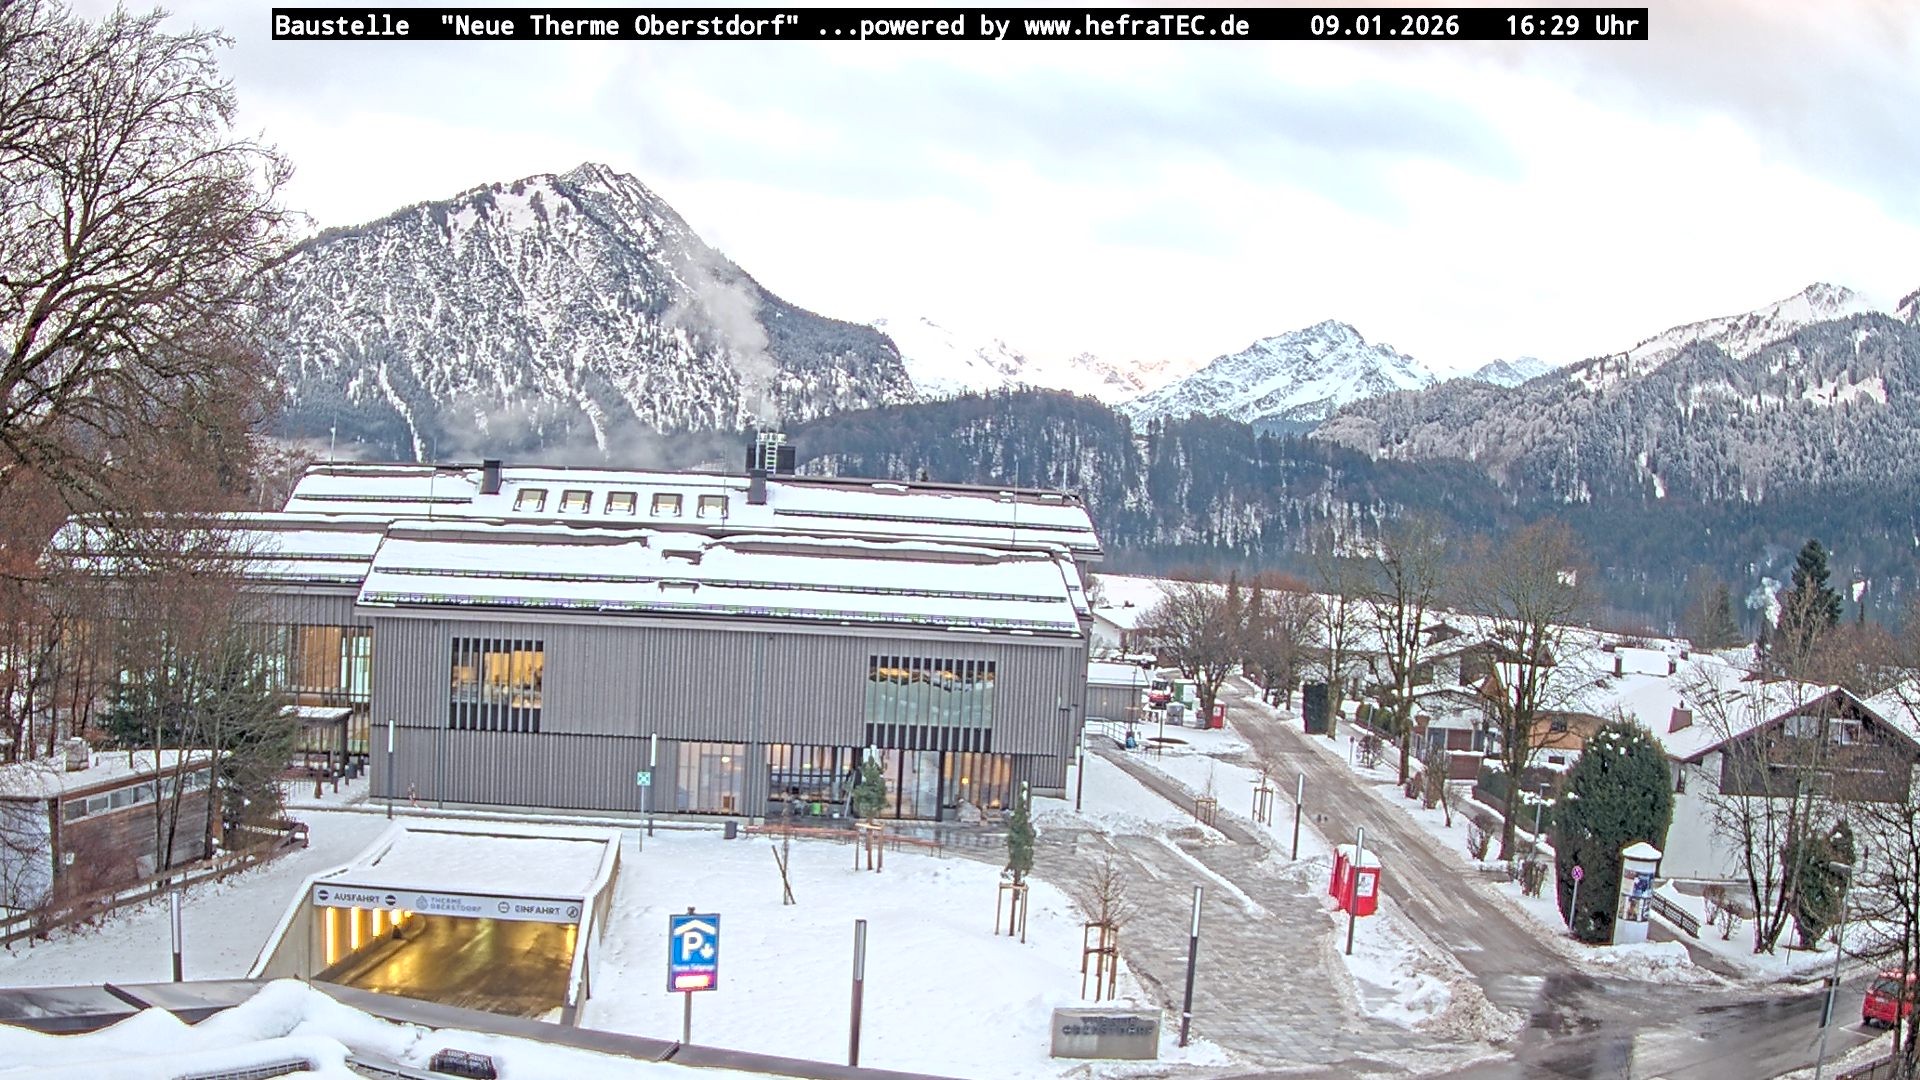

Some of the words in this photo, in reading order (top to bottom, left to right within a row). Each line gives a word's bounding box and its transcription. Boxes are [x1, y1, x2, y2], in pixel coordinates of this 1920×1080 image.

[334, 892, 380, 904] AUSFAHRT
[515, 904, 561, 915] EINFAHRT
[682, 931, 704, 961] P
